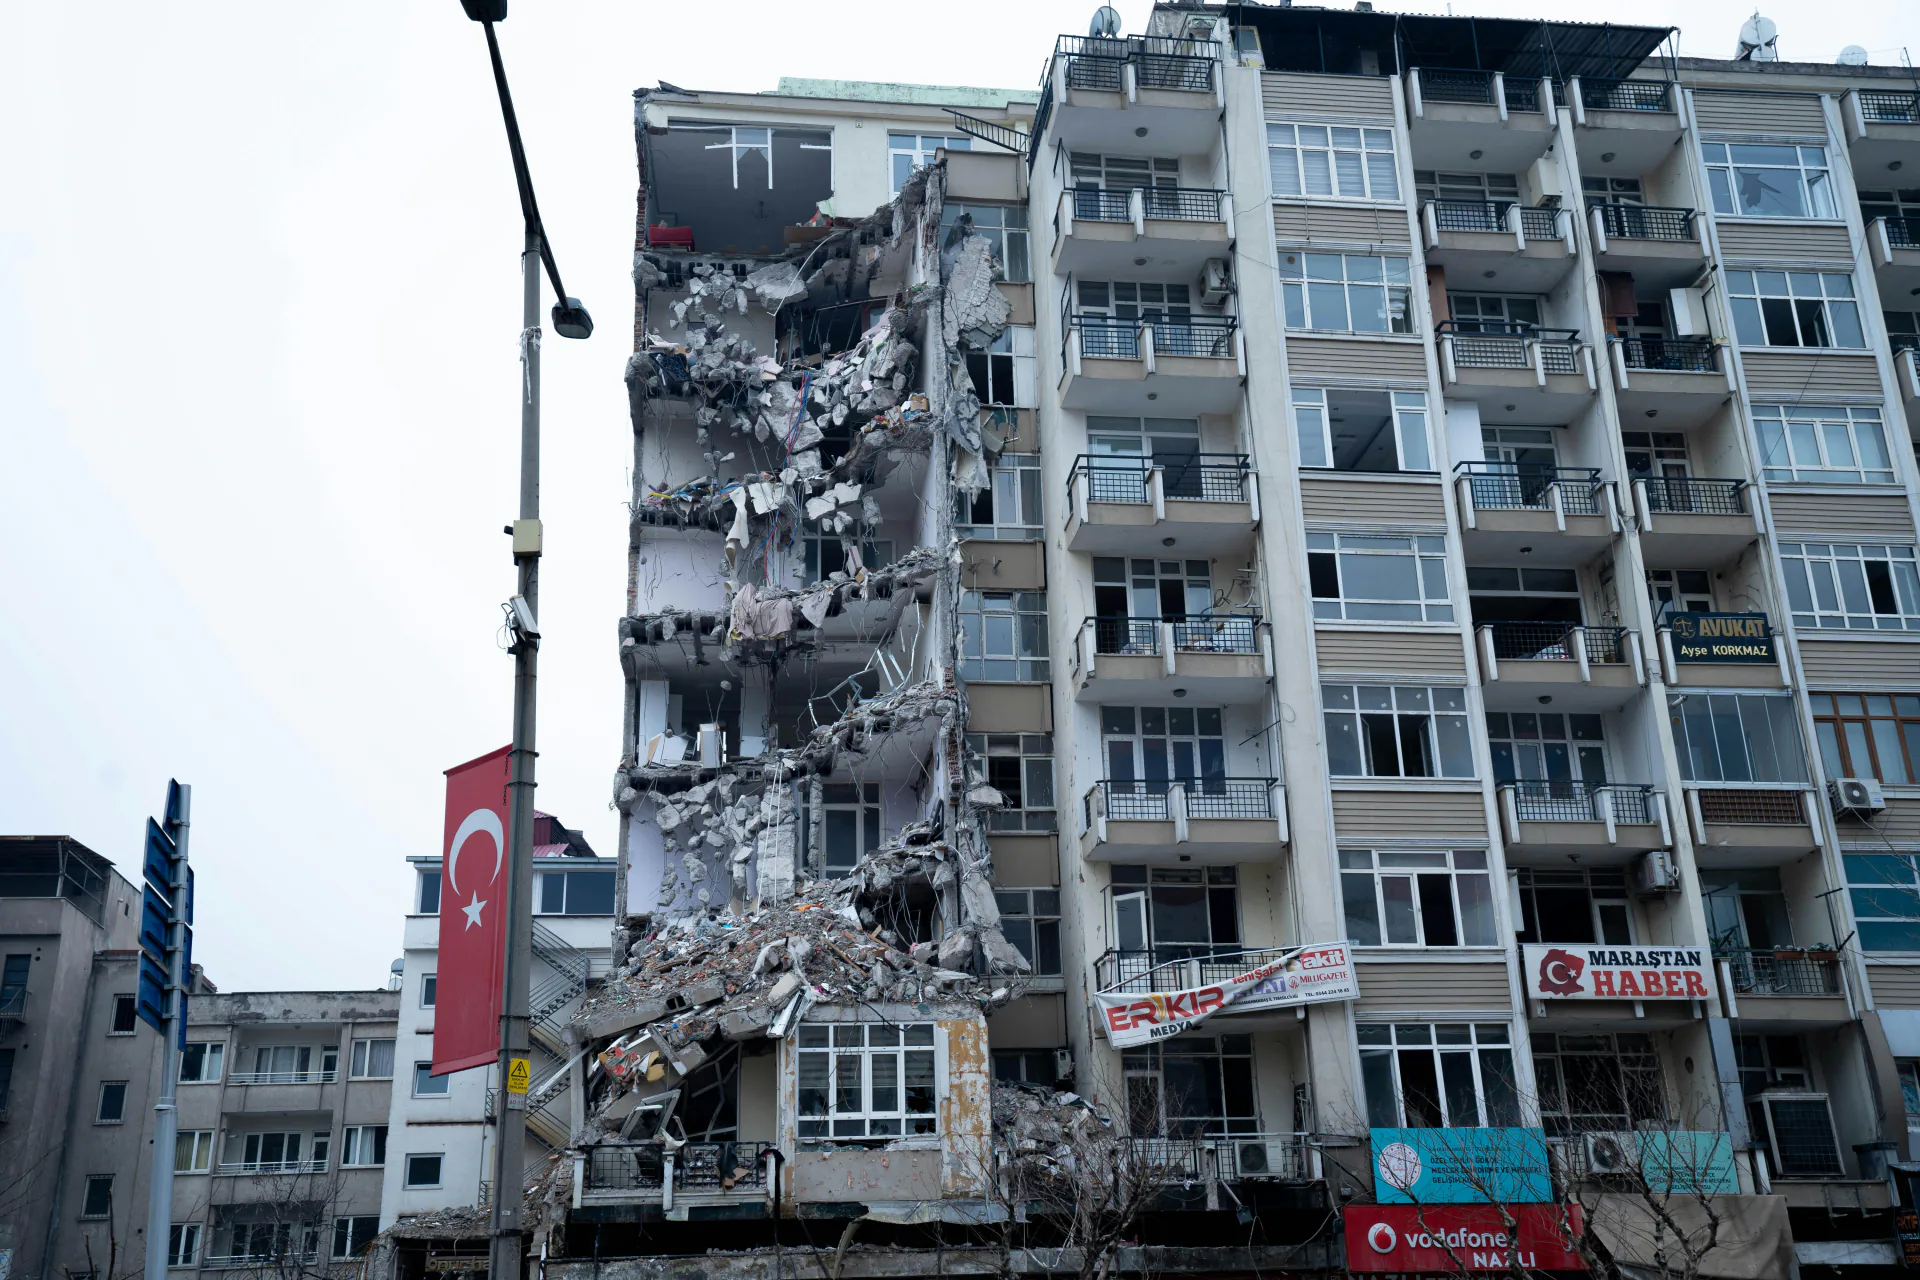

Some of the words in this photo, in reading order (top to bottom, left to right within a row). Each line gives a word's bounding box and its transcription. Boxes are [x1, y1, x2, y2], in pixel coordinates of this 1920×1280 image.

[1699, 618, 1765, 637] AVUKAT
[1681, 645, 1708, 657] Ayşe
[1712, 645, 1768, 656] KORKMAZ
[1303, 951, 1345, 969] akit
[1588, 951, 1702, 968] MARAŞTAN
[1591, 970, 1708, 996] HABER
[1150, 1020, 1193, 1038] MEDYA
[1405, 1227, 1508, 1249] vodafone
